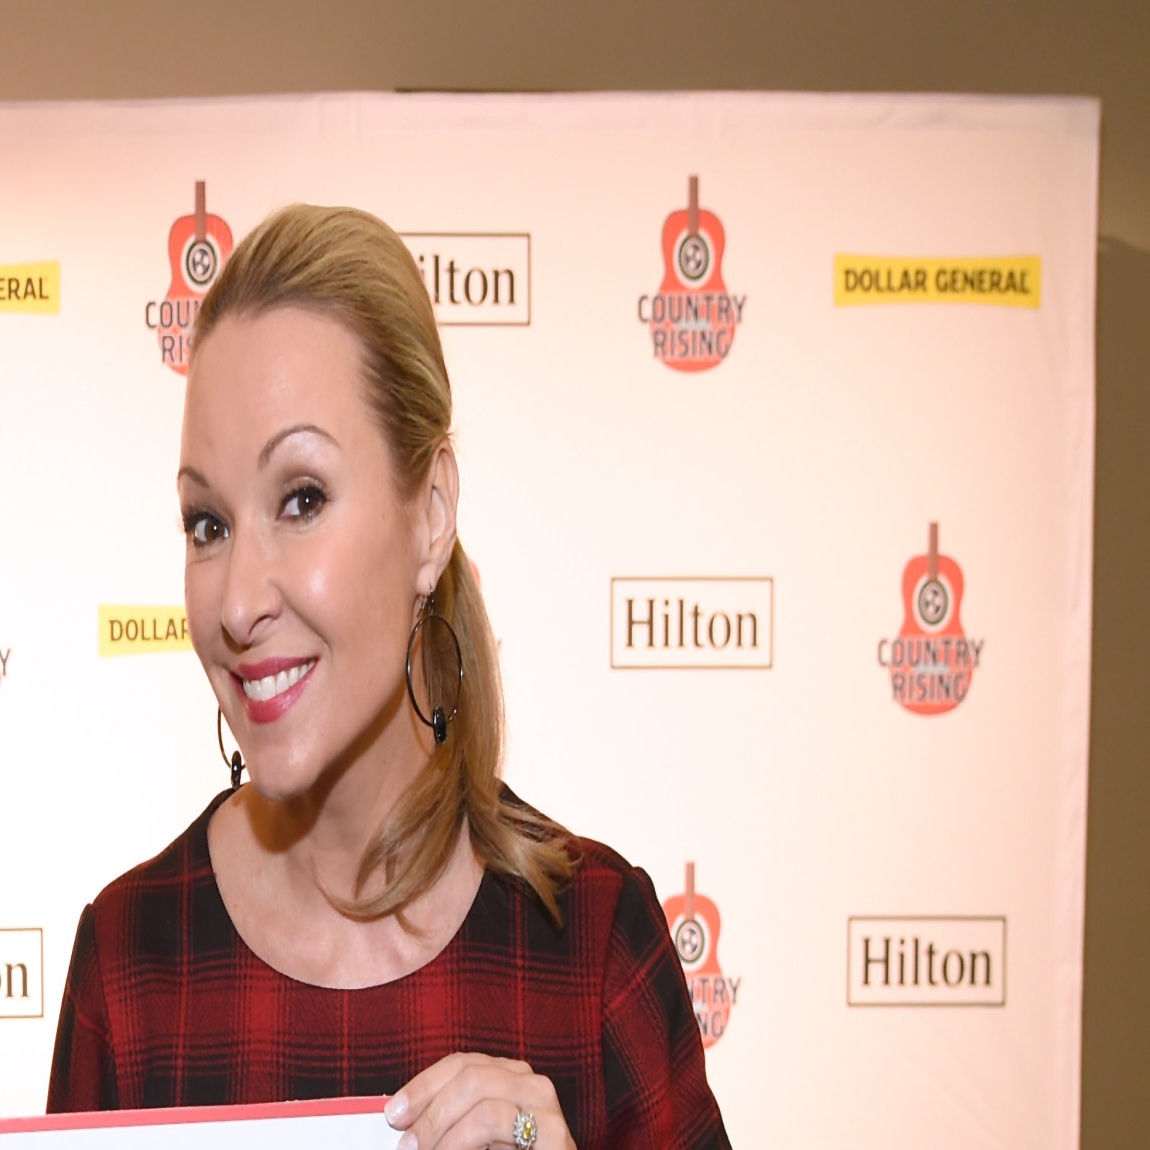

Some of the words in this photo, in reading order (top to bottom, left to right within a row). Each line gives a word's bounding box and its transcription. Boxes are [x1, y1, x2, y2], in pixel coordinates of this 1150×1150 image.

[845, 269, 927, 292] DOLLAR
[936, 269, 1029, 294] GENERAL
[638, 294, 747, 324] COUNTRY
[652, 329, 731, 359] RISING
[625, 599, 758, 648] Hilton
[878, 637, 984, 667] COUNTRY
[893, 672, 968, 702] RISING
[864, 938, 991, 985] Hilton
